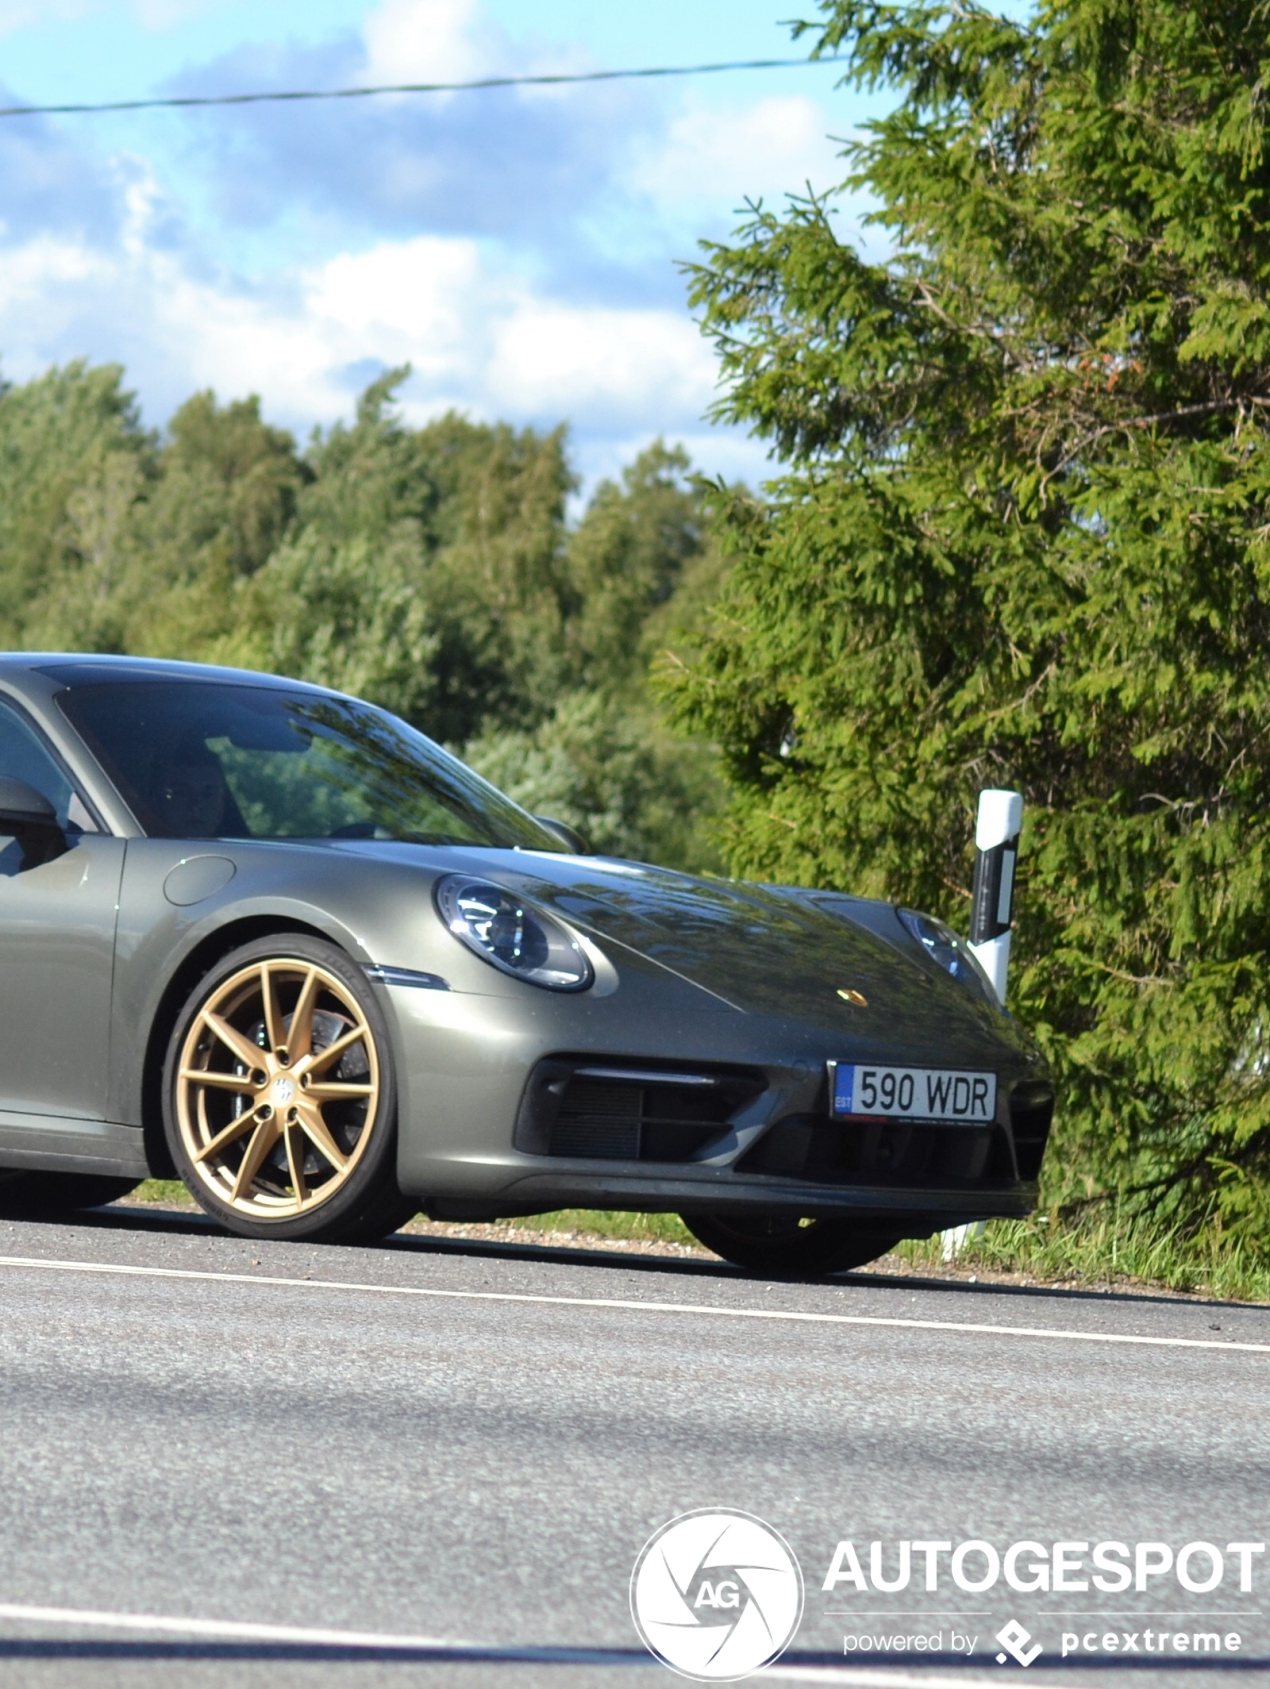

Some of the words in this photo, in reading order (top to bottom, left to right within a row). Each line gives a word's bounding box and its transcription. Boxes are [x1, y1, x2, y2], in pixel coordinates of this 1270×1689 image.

[835, 1096, 851, 1108] EST
[861, 1071, 914, 1111] 590
[926, 1074, 989, 1116] WDR
